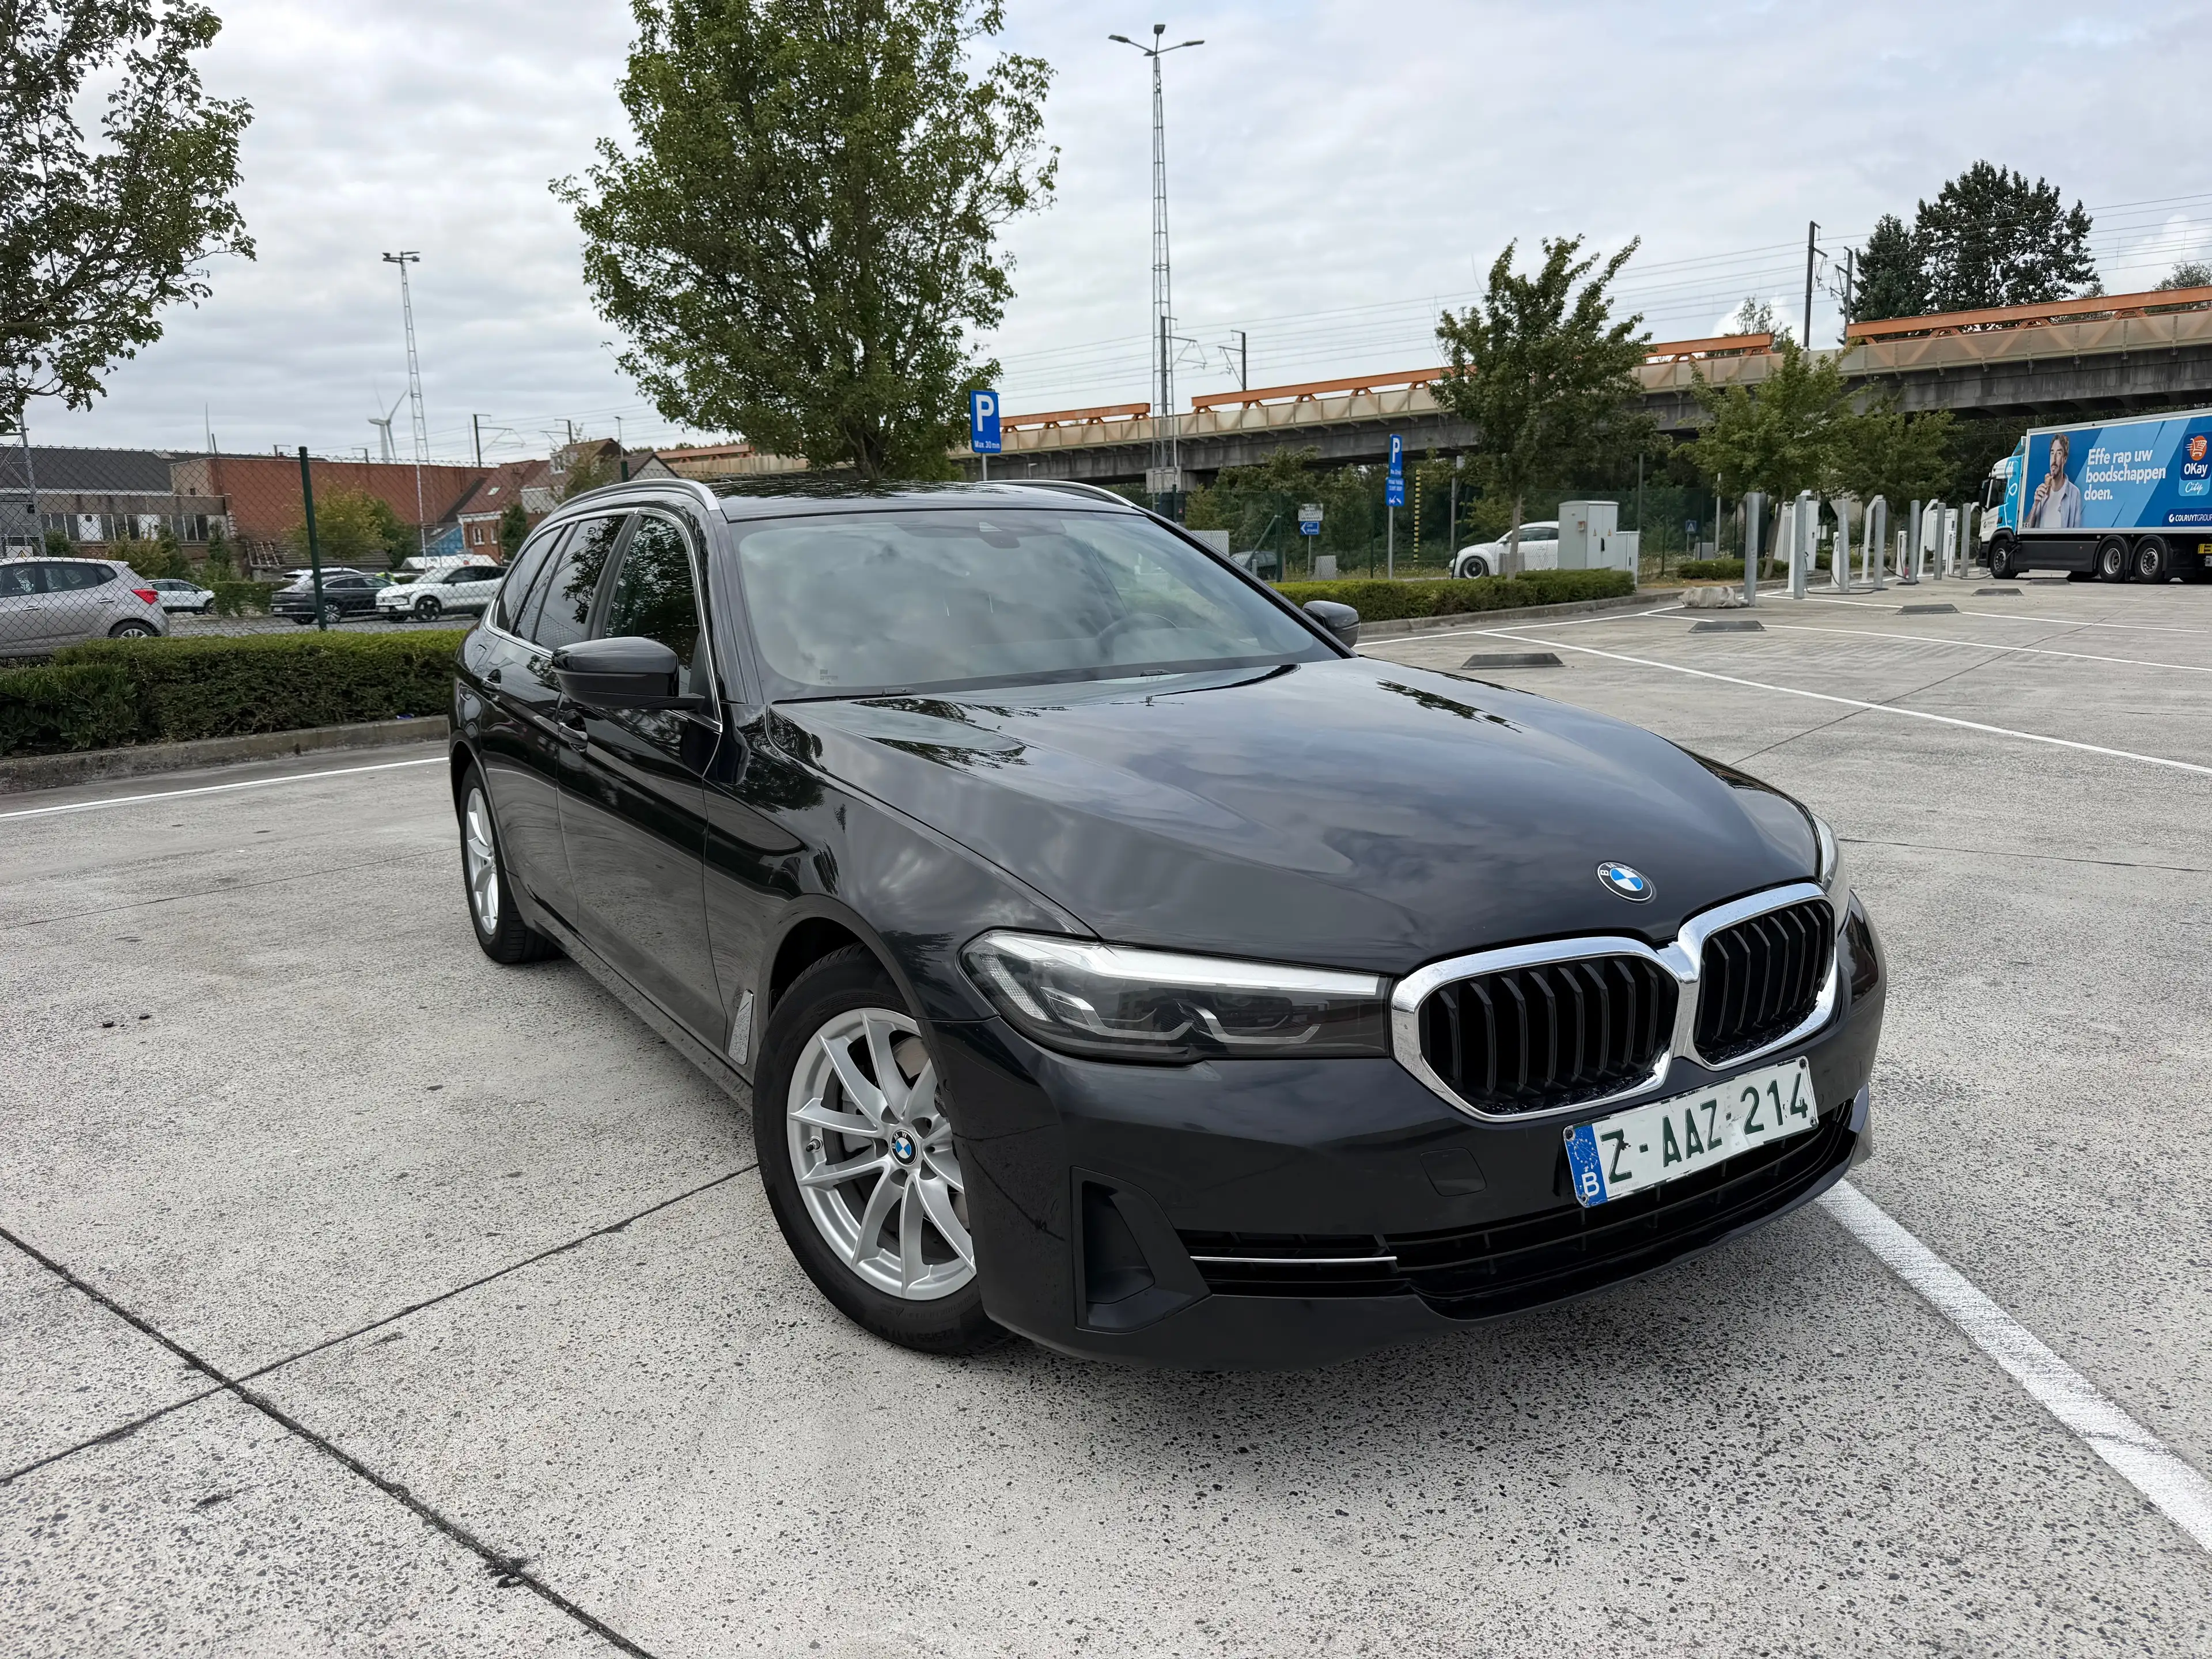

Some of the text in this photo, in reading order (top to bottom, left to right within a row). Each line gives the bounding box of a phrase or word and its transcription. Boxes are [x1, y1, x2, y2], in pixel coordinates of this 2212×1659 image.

[976, 394, 994, 431] P
[1392, 437, 1400, 463] P
[2088, 448, 2153, 466] Effe rap uw
[2086, 464, 2166, 484] boodschappen
[2184, 463, 2208, 477] OKay
[2084, 484, 2113, 501] doen.
[2185, 482, 2203, 494] City
[1582, 1172, 1600, 1196] B
